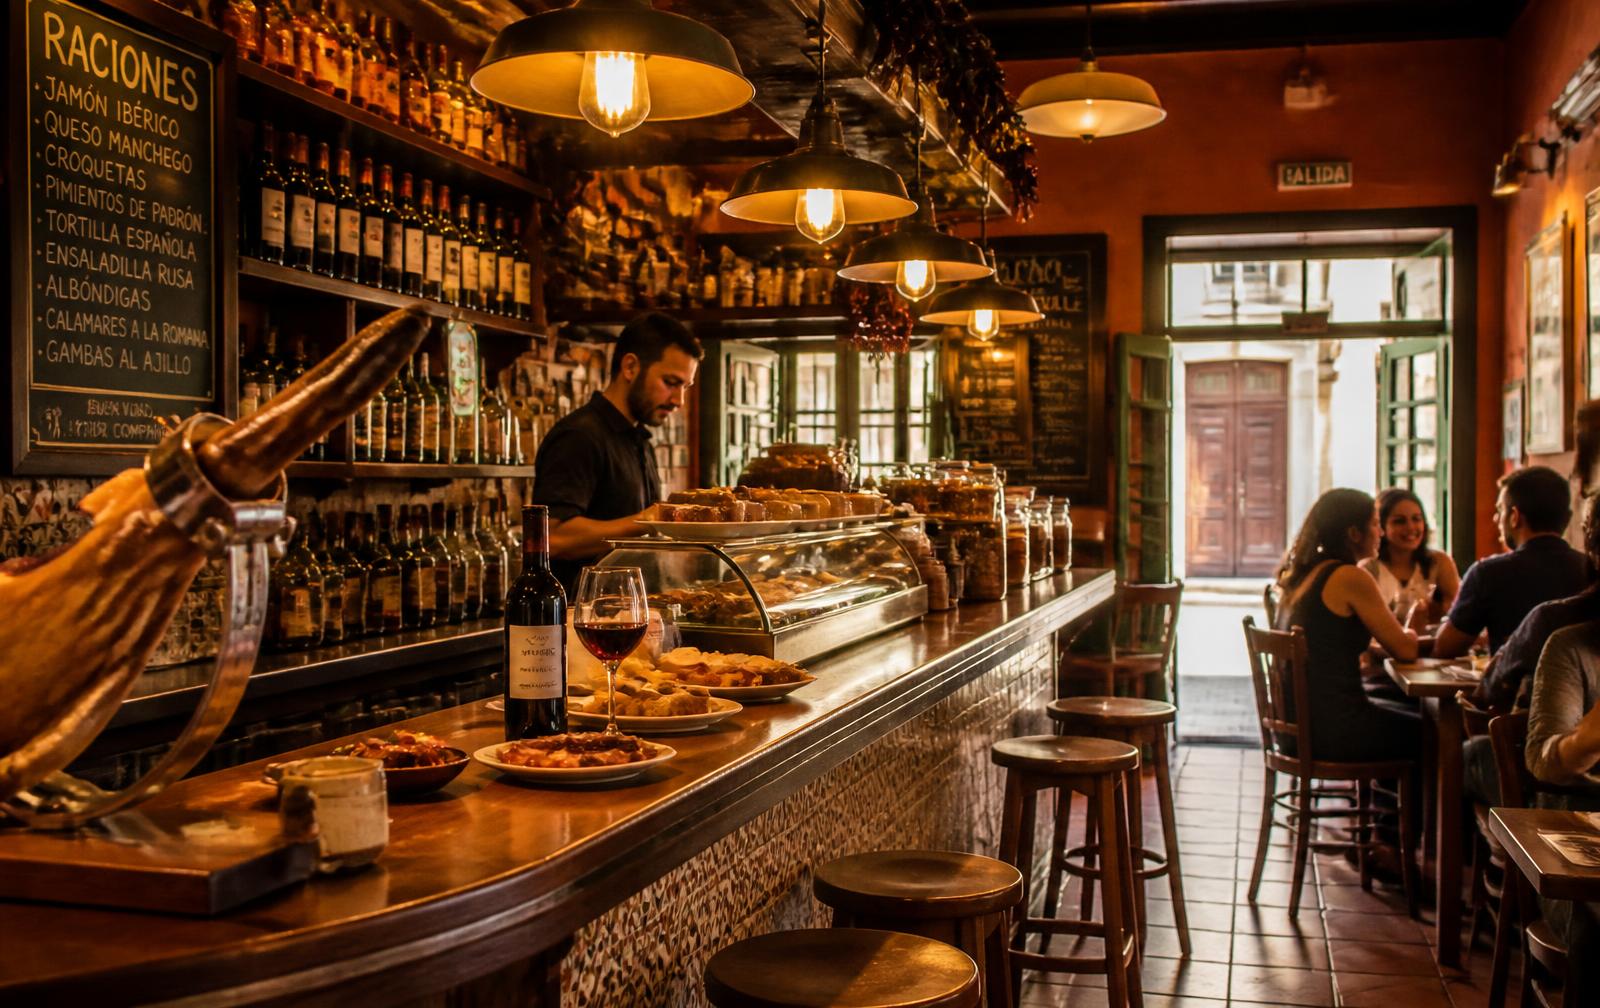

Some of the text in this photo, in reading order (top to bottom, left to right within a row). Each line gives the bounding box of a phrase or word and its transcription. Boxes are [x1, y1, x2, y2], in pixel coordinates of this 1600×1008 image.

[44, 11, 198, 111] RACIONES
[44, 75, 180, 140] JAMÓN IBÉRICO
[44, 110, 192, 174] QUESO MANCHEGO
[45, 144, 147, 191] CROQUETAS
[1286, 166, 1346, 183] SALIDA
[46, 174, 125, 214] PIMIENTOS
[130, 198, 147, 220] DE
[46, 209, 197, 262] TORTILLA ESPAÑOLA
[46, 242, 194, 290] ENSALADILLA RUSA
[45, 273, 152, 312] ALBÓNDIGAS
[46, 308, 209, 350] CALAMARES A LA ROMANA
[46, 340, 191, 375] GAMBAS AL AJILLO
